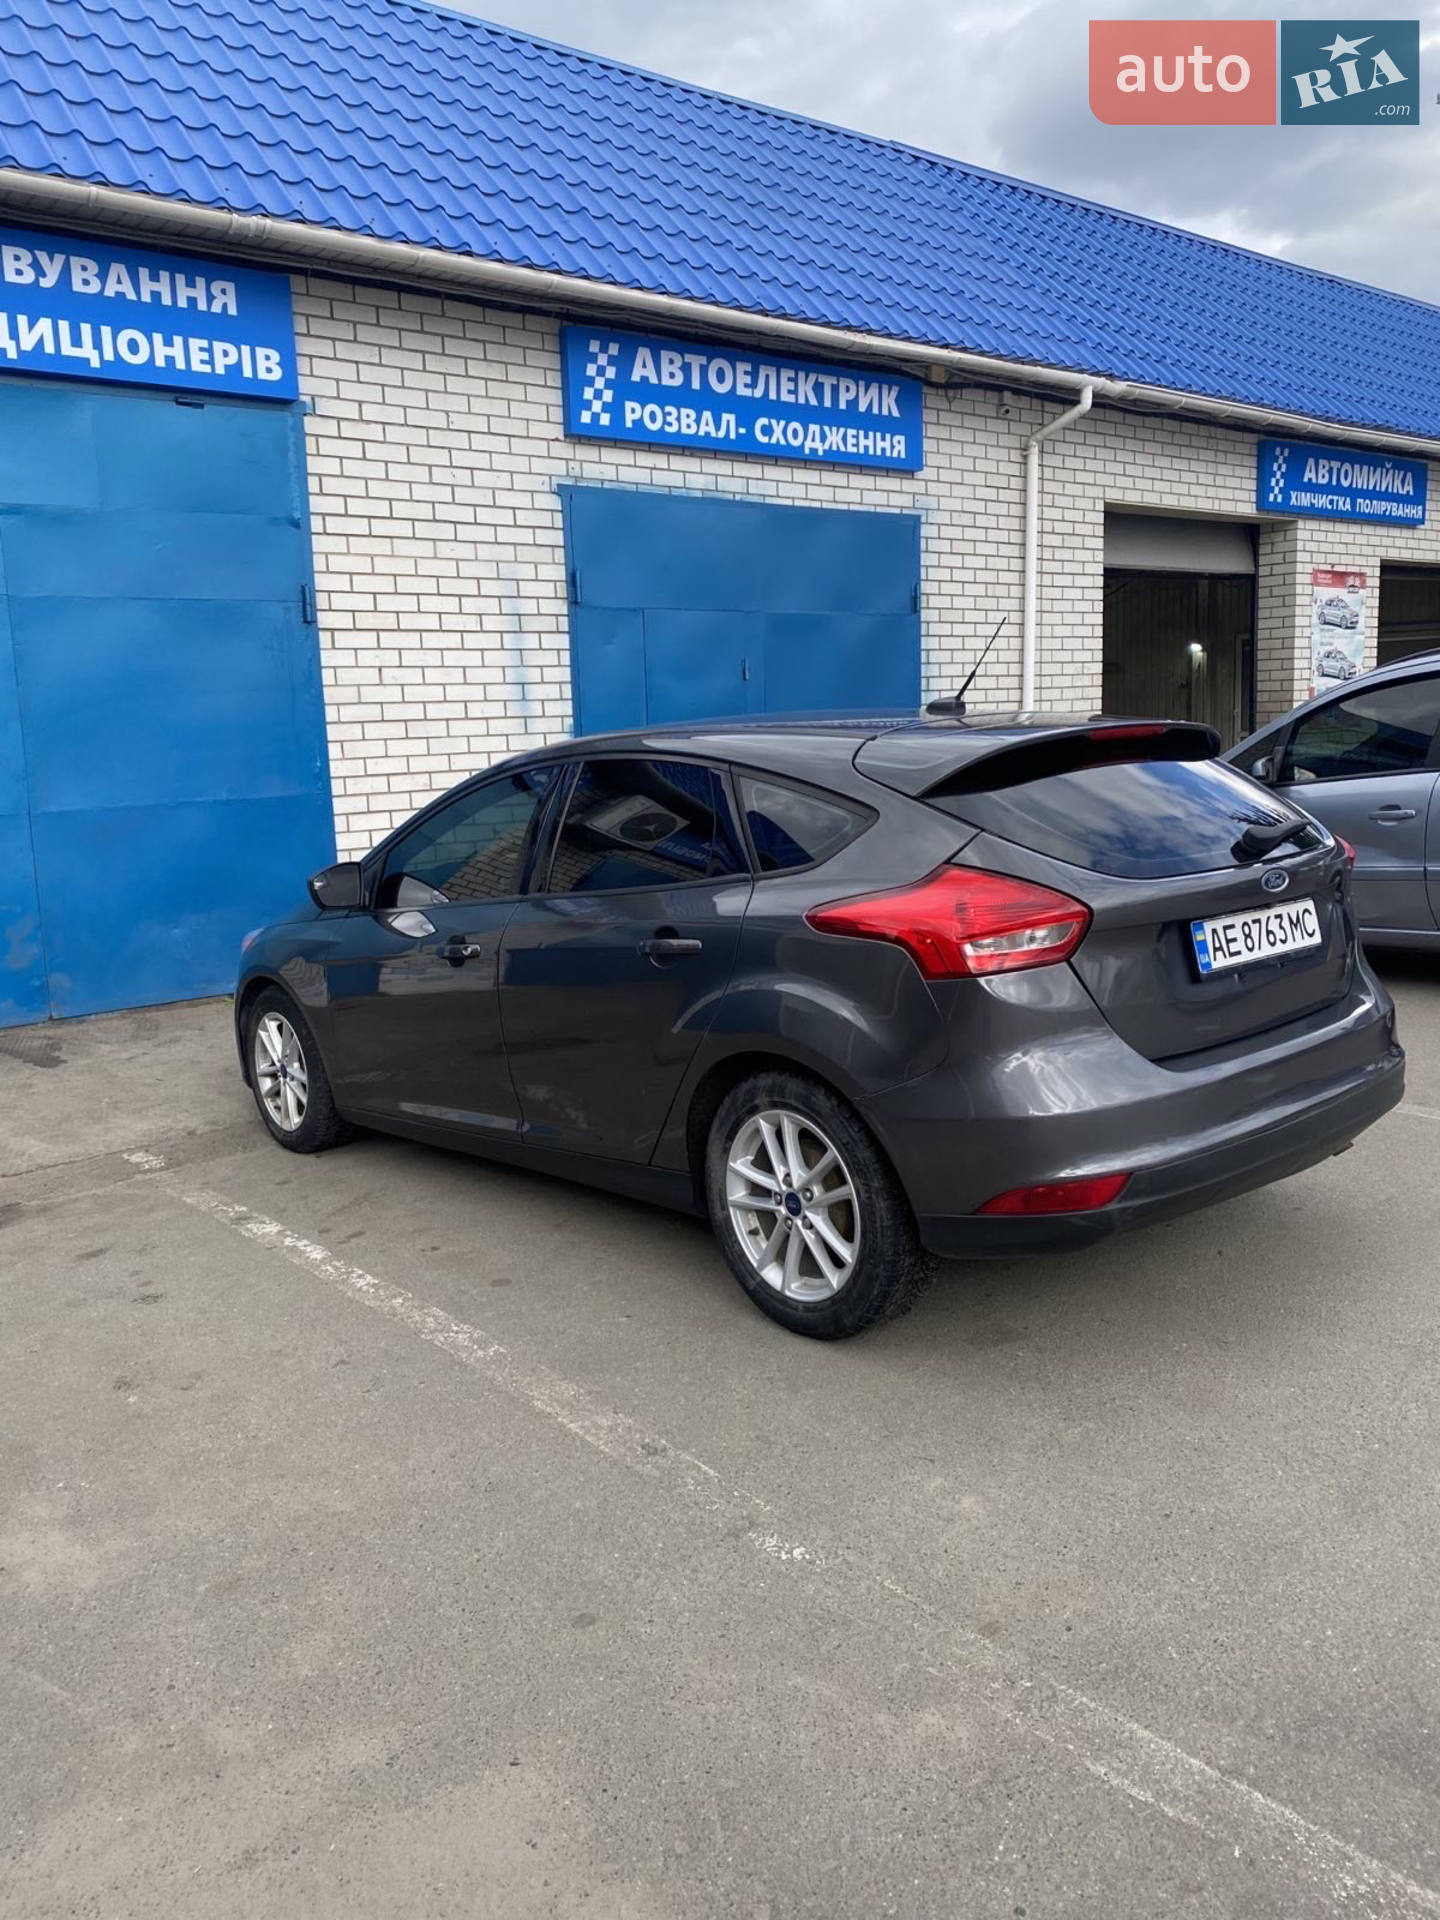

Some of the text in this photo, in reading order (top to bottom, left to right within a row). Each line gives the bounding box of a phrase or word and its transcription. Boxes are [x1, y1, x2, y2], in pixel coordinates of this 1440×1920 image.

[1, 244, 238, 316] ВУВАННЯ
[630, 346, 901, 418] АВТОЕЛЕКТРИК
[624, 400, 906, 459] РОЗВАЛ- СХОДЖЕННЯ
[1289, 490, 1423, 519] ХІМЧИСТКА ПОЛІРУВАННЯ
[1303, 457, 1414, 496] АВТОМИЙКА
